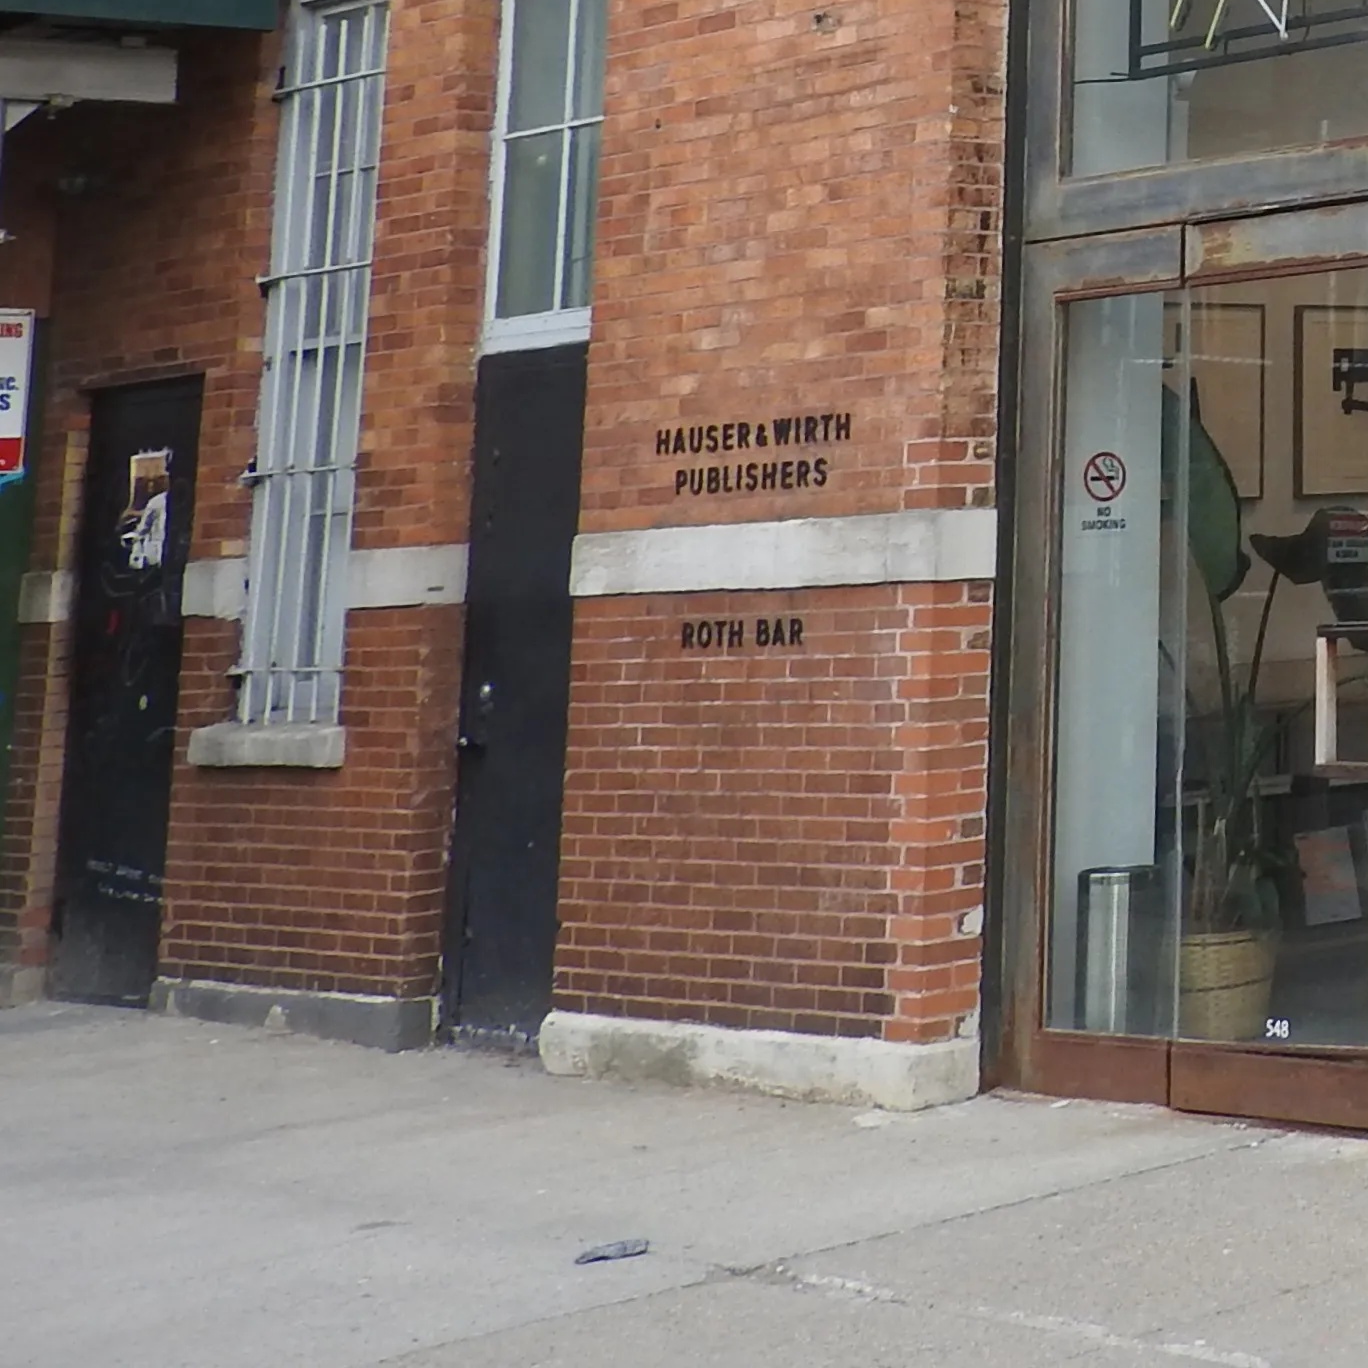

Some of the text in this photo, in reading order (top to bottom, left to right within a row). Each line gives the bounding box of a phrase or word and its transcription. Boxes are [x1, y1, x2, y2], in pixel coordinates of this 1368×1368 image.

[675, 457, 829, 496] PUBLISHERS
[1097, 506, 1111, 517] NO
[680, 617, 804, 650] ROTH BAR
[1265, 1018, 1290, 1039] 548
